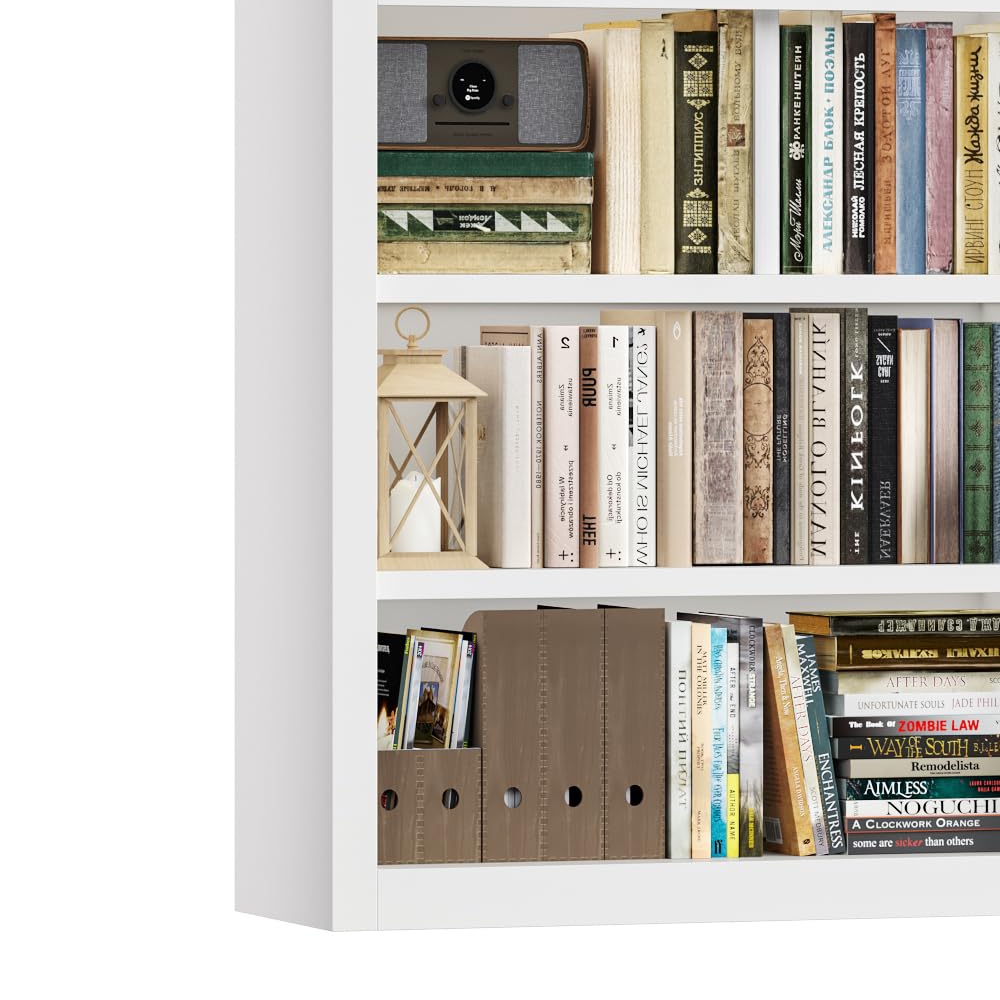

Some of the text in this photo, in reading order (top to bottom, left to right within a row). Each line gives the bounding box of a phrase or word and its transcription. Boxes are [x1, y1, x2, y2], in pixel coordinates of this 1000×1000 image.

[789, 45, 805, 161] ФРАНКЕНШТЕЙН
[853, 53, 866, 191] ЛЕСНАЯ КРЕПОСТЬ
[964, 46, 984, 164] Жажда жизни
[823, 27, 835, 252] АЛЕКСАНДР БЛОК ПОЭМЫ
[964, 169, 985, 264] ИРВИНГ СТОУН
[797, 643, 814, 709] MAXWELL
[810, 654, 822, 693] JAMES
[899, 720, 979, 732] ZOMBIE LAW
[864, 780, 929, 798] AIMLESS
[912, 761, 980, 771] Remodelista
[819, 753, 843, 849] ENCHANTRESS
[852, 818, 980, 829] A CLOCKWORK ORANGE
[885, 799, 997, 816] NOGUCHI
[852, 840, 876, 848] some
[925, 837, 944, 846] than
[946, 837, 974, 846] others
